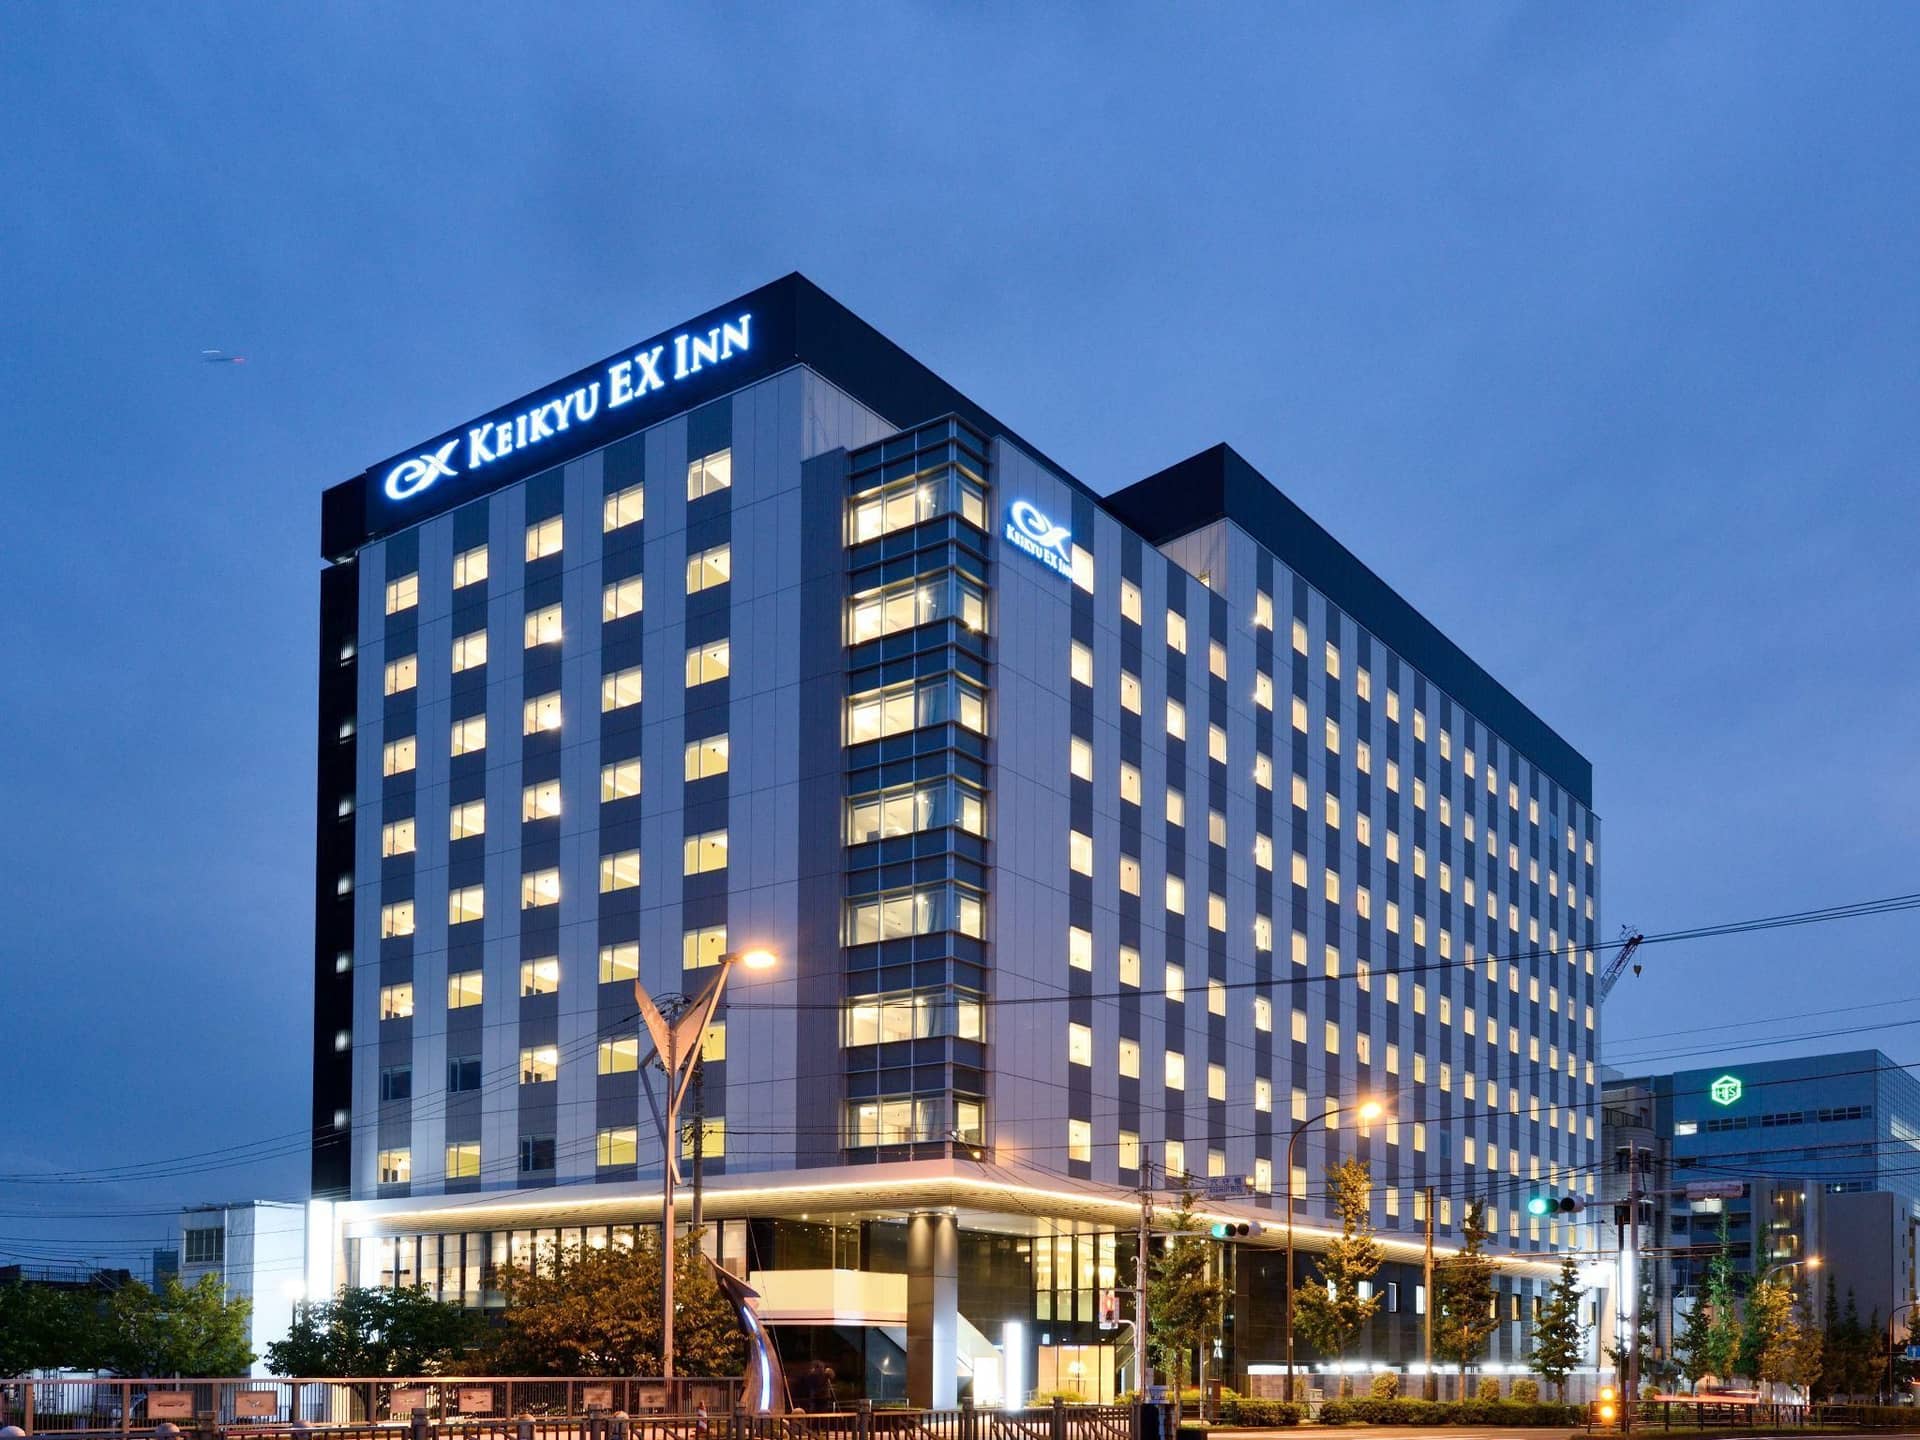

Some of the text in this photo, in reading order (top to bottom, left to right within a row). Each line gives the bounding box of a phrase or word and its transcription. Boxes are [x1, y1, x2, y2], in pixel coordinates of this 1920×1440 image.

[468, 382, 600, 469] KEIKYU
[608, 345, 664, 408] EX
[674, 314, 751, 379] INN
